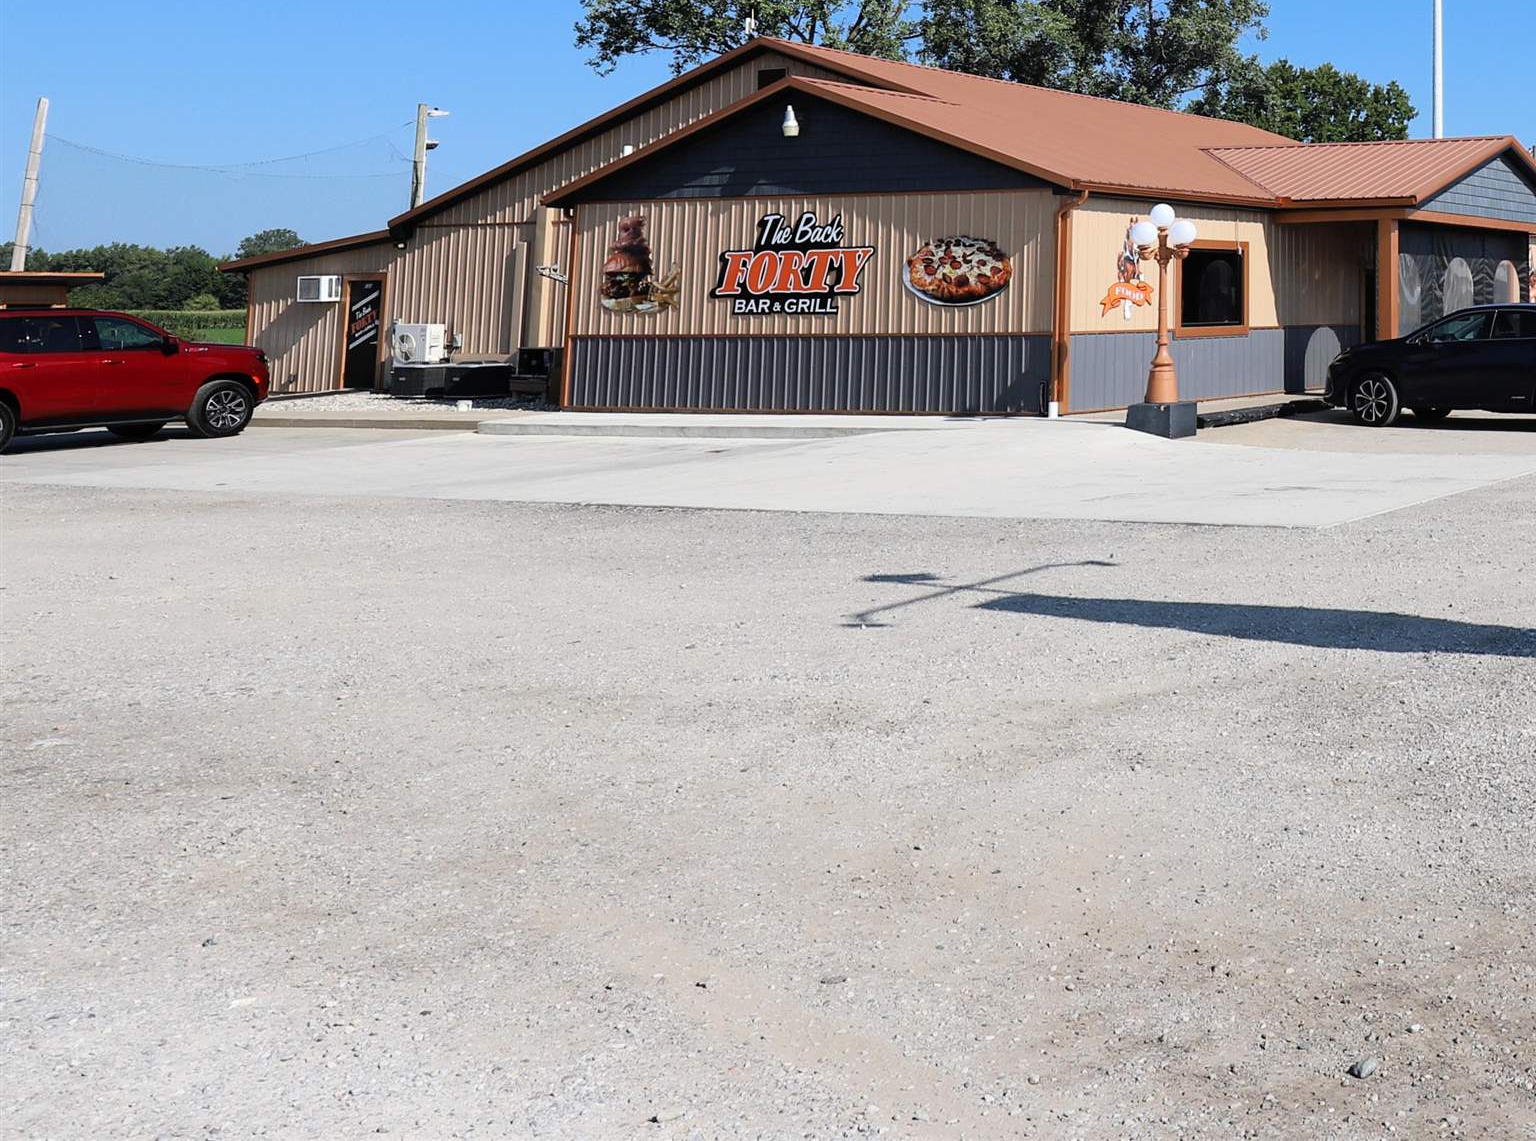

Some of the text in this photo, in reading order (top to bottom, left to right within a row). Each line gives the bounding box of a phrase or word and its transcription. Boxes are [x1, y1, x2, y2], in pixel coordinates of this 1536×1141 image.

[760, 212, 843, 245] The Back
[715, 247, 874, 296] FORTY
[1115, 286, 1144, 300] FOOD
[734, 298, 838, 314] BAR & GRILL
